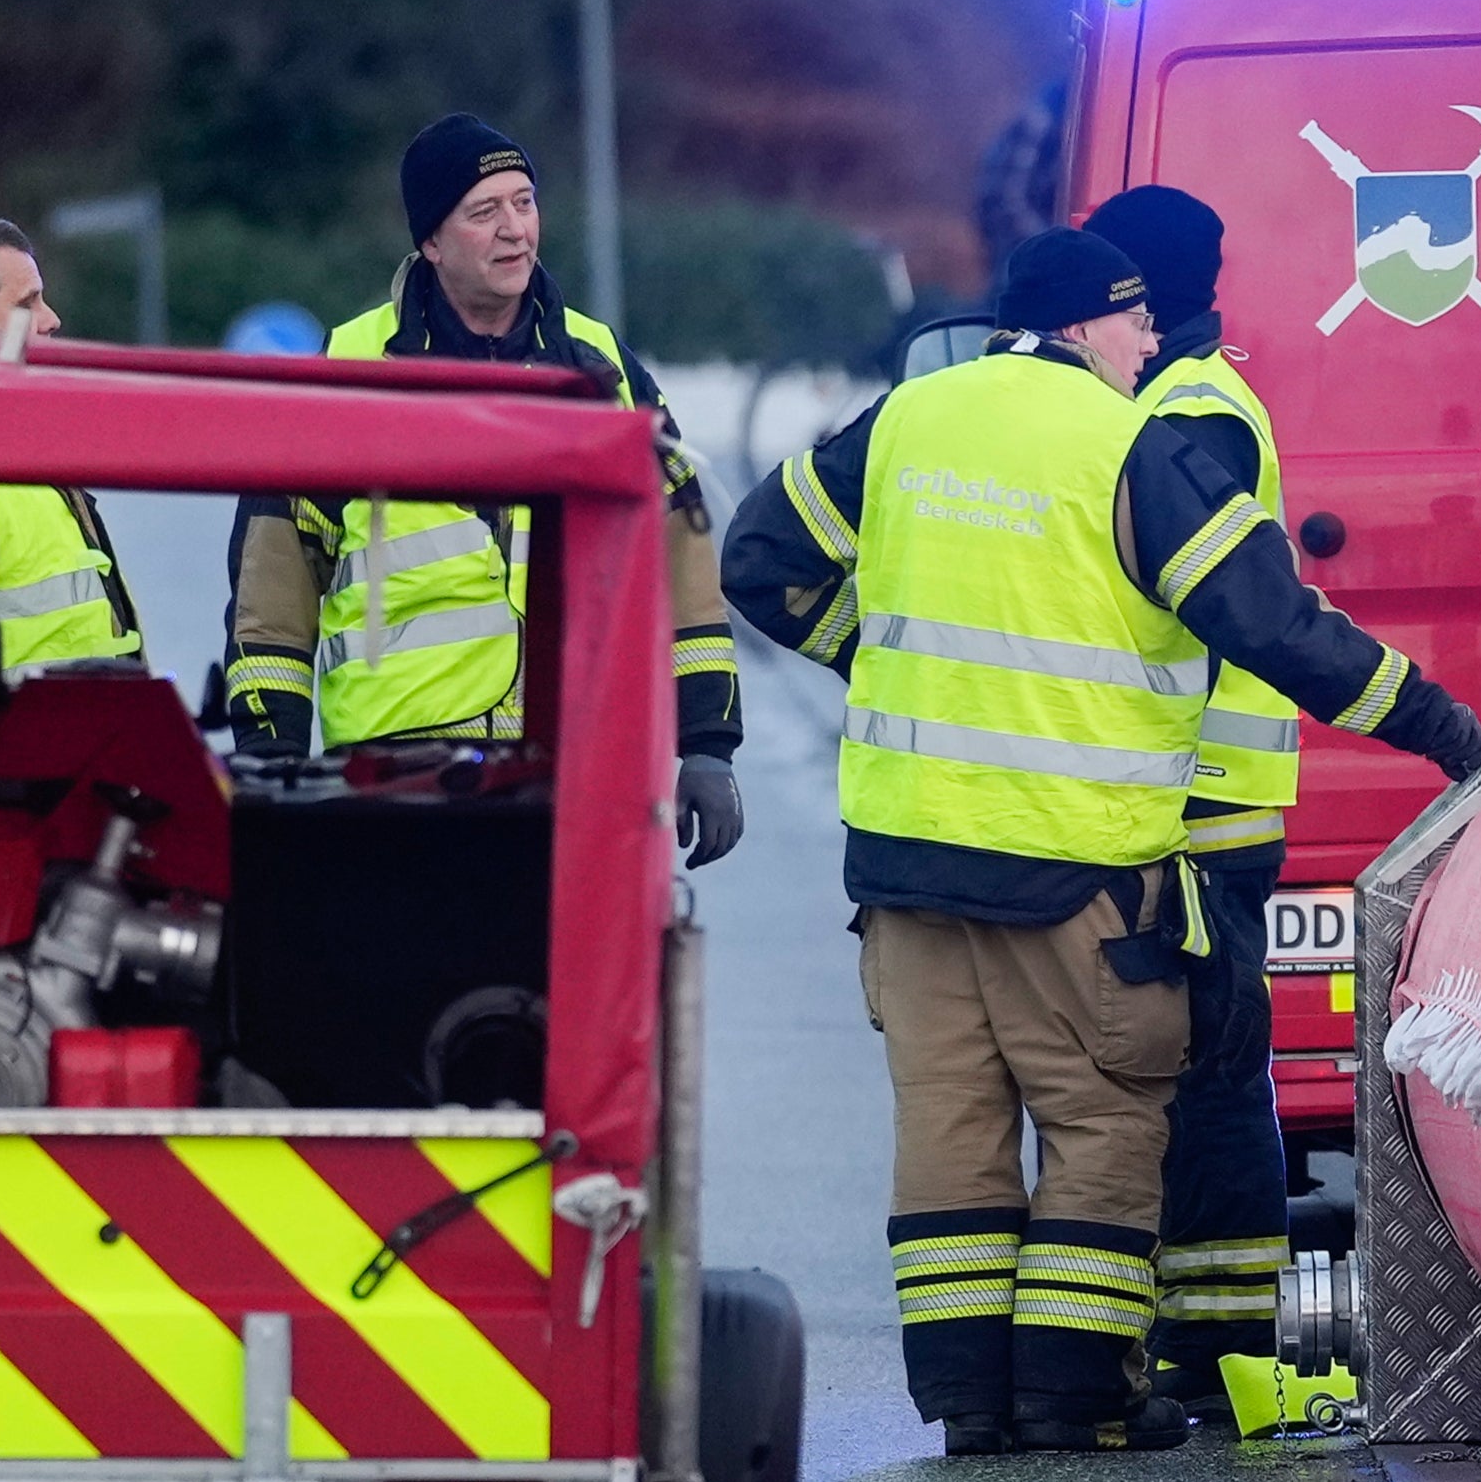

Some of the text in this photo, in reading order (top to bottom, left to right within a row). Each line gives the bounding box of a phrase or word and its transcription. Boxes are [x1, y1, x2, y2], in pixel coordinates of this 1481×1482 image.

[897, 465, 1053, 514] Gribskov
[915, 499, 1045, 537] Beredskab
[1276, 904, 1345, 949] DD
[1266, 963, 1293, 972] MAN
[1295, 963, 1332, 972] TRUCK
